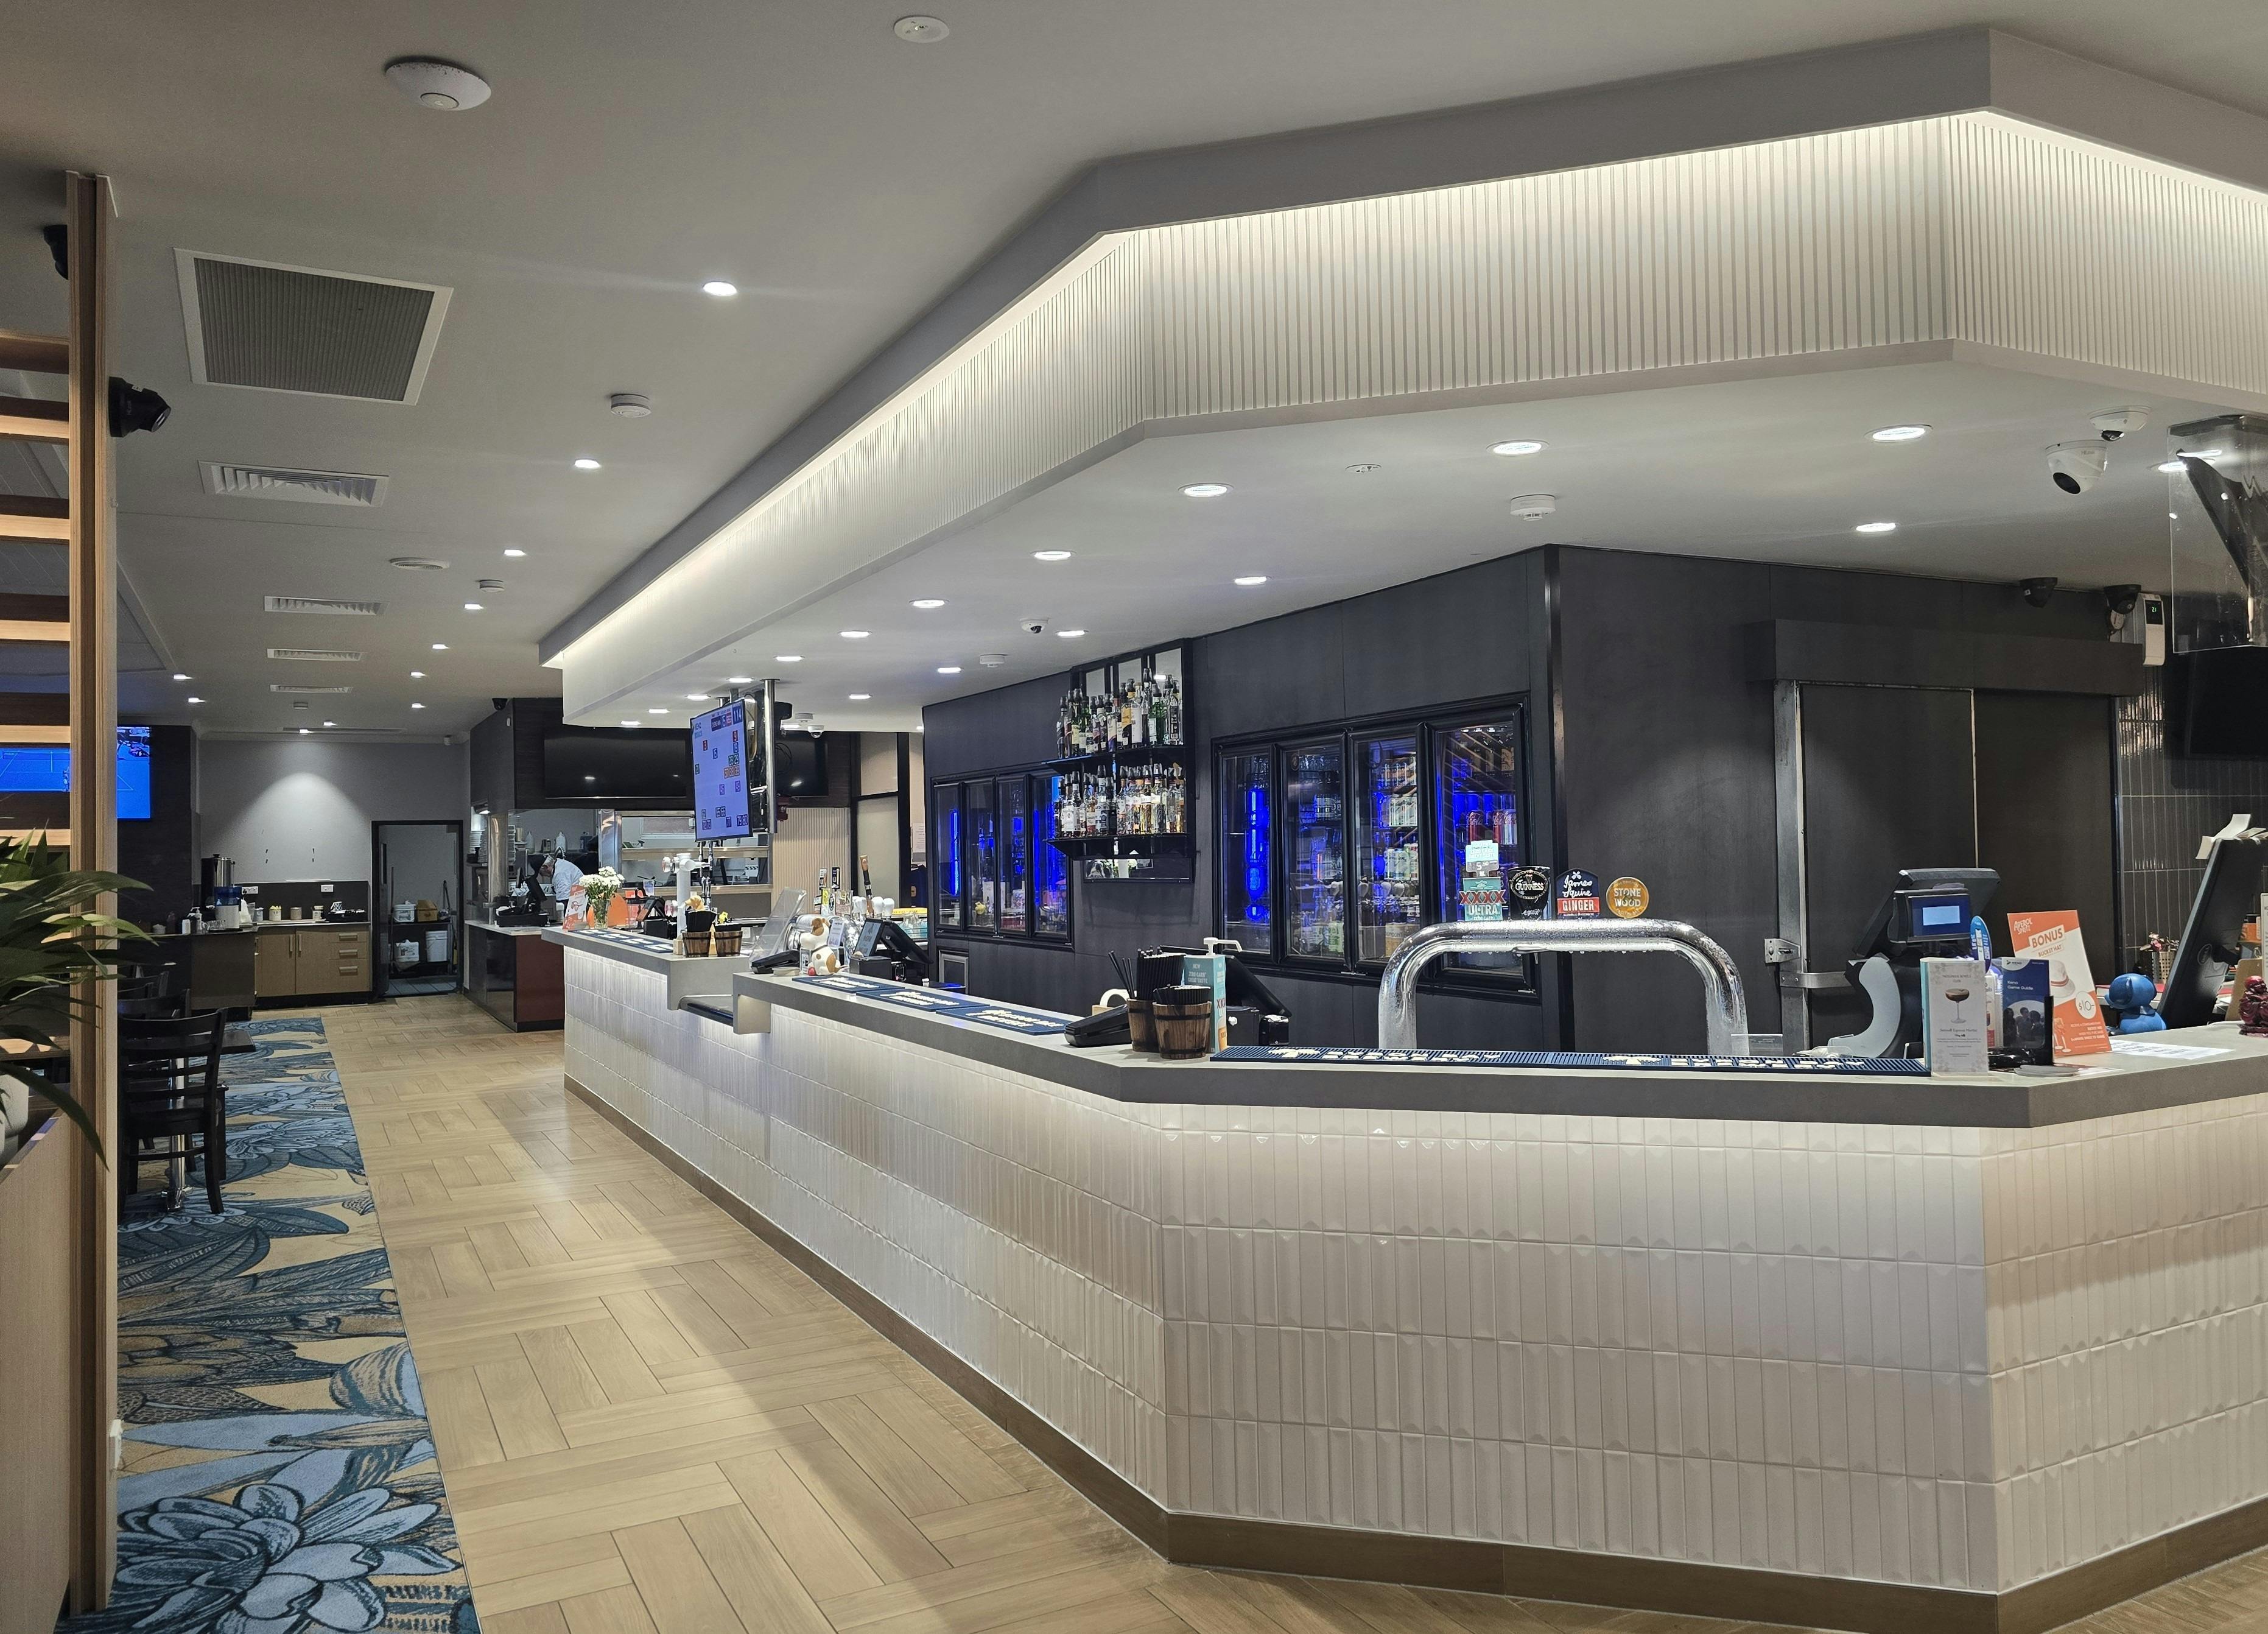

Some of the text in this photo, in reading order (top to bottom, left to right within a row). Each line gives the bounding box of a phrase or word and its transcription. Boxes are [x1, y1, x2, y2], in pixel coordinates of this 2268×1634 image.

[1515, 882, 1544, 891] GUINNESS
[1564, 875, 1593, 889] James
[1459, 890, 1507, 905] XXXX
[1562, 886, 1592, 898] Squire
[1614, 887, 1641, 897] STONE
[1562, 900, 1595, 911] GINGER
[1614, 898, 1641, 907] WOOD
[1468, 904, 1499, 915] ULTRA
[2013, 917, 2033, 931] APEROL
[2032, 928, 2063, 948] BONUS
[2038, 948, 2054, 957] BUCKET
